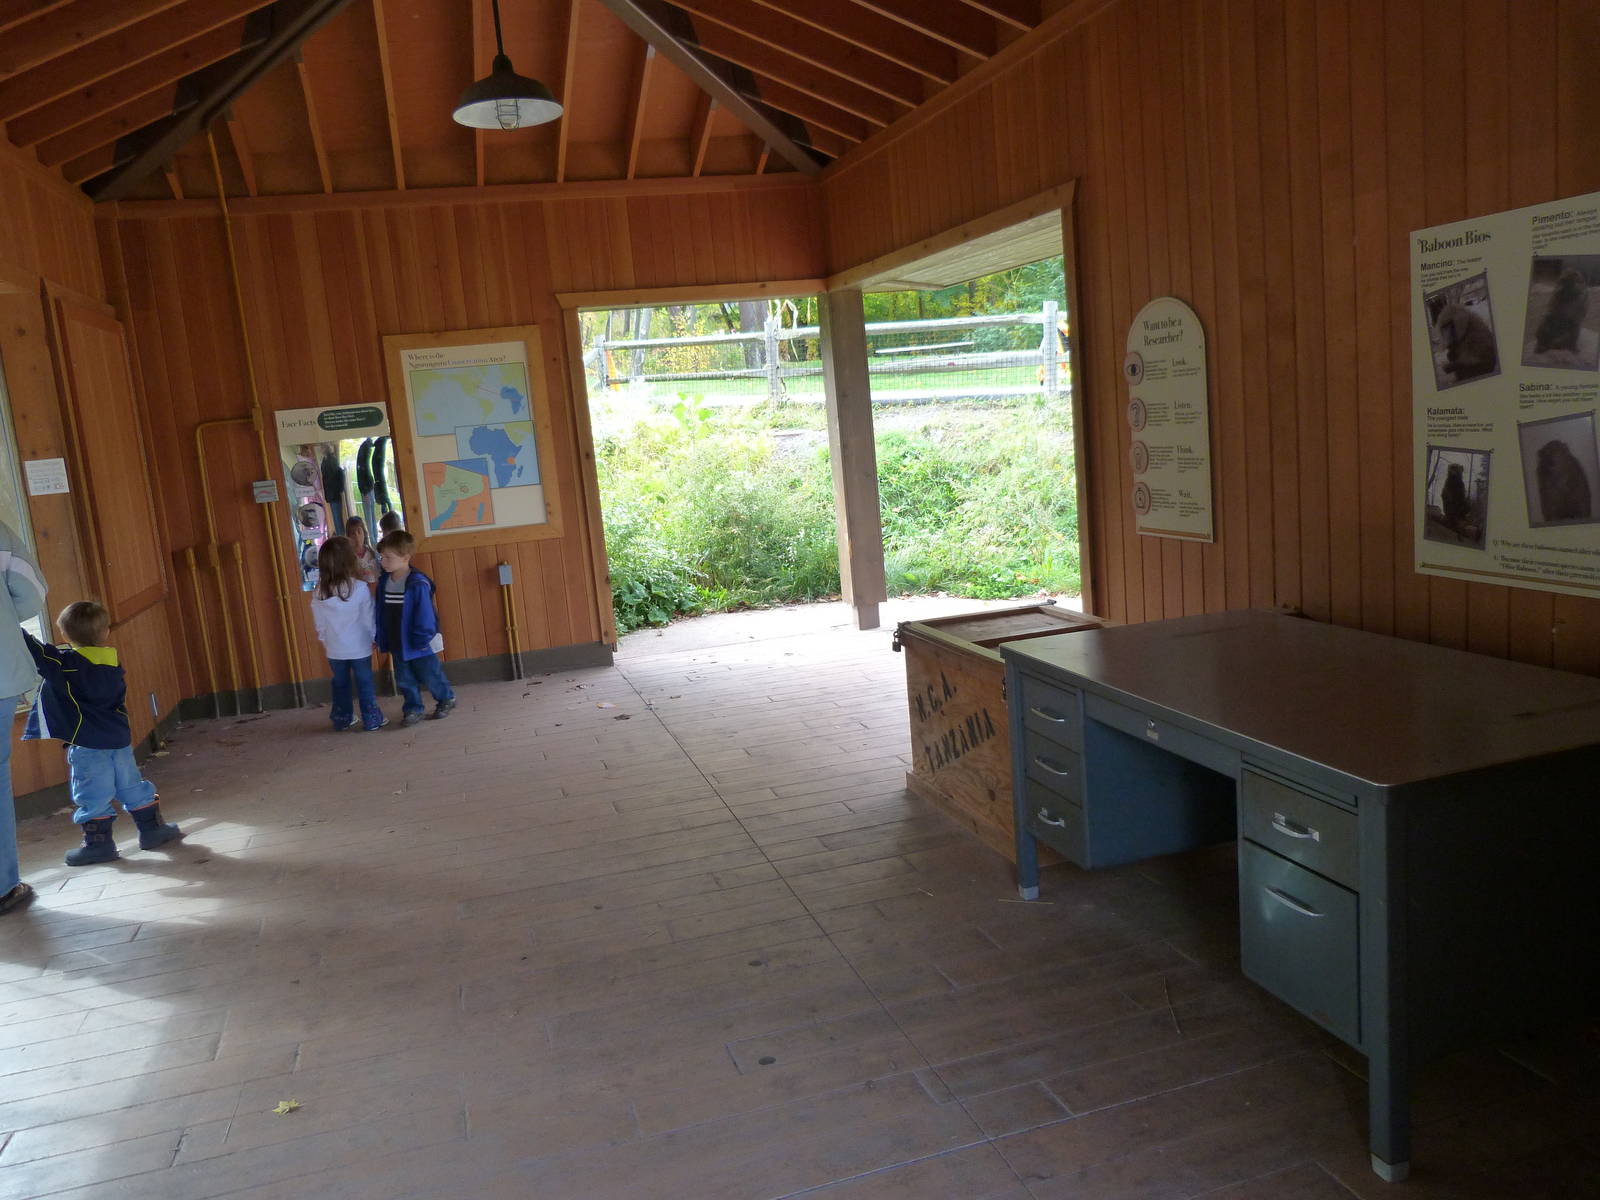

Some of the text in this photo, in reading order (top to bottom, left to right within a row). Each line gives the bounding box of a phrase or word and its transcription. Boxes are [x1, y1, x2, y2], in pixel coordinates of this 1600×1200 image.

[1532, 210, 1573, 225] Pimento:
[1418, 229, 1492, 254] Baboon Bios
[1420, 259, 1456, 272] Mancino:
[1143, 320, 1160, 331] Want
[1160, 320, 1168, 329] to
[1168, 316, 1177, 328] be
[1143, 330, 1183, 347] Researcher?
[408, 352, 427, 361] Where
[1519, 383, 1553, 392] Sabina:
[1426, 407, 1465, 416] Kalamata:
[925, 707, 996, 774] TANZANIA
